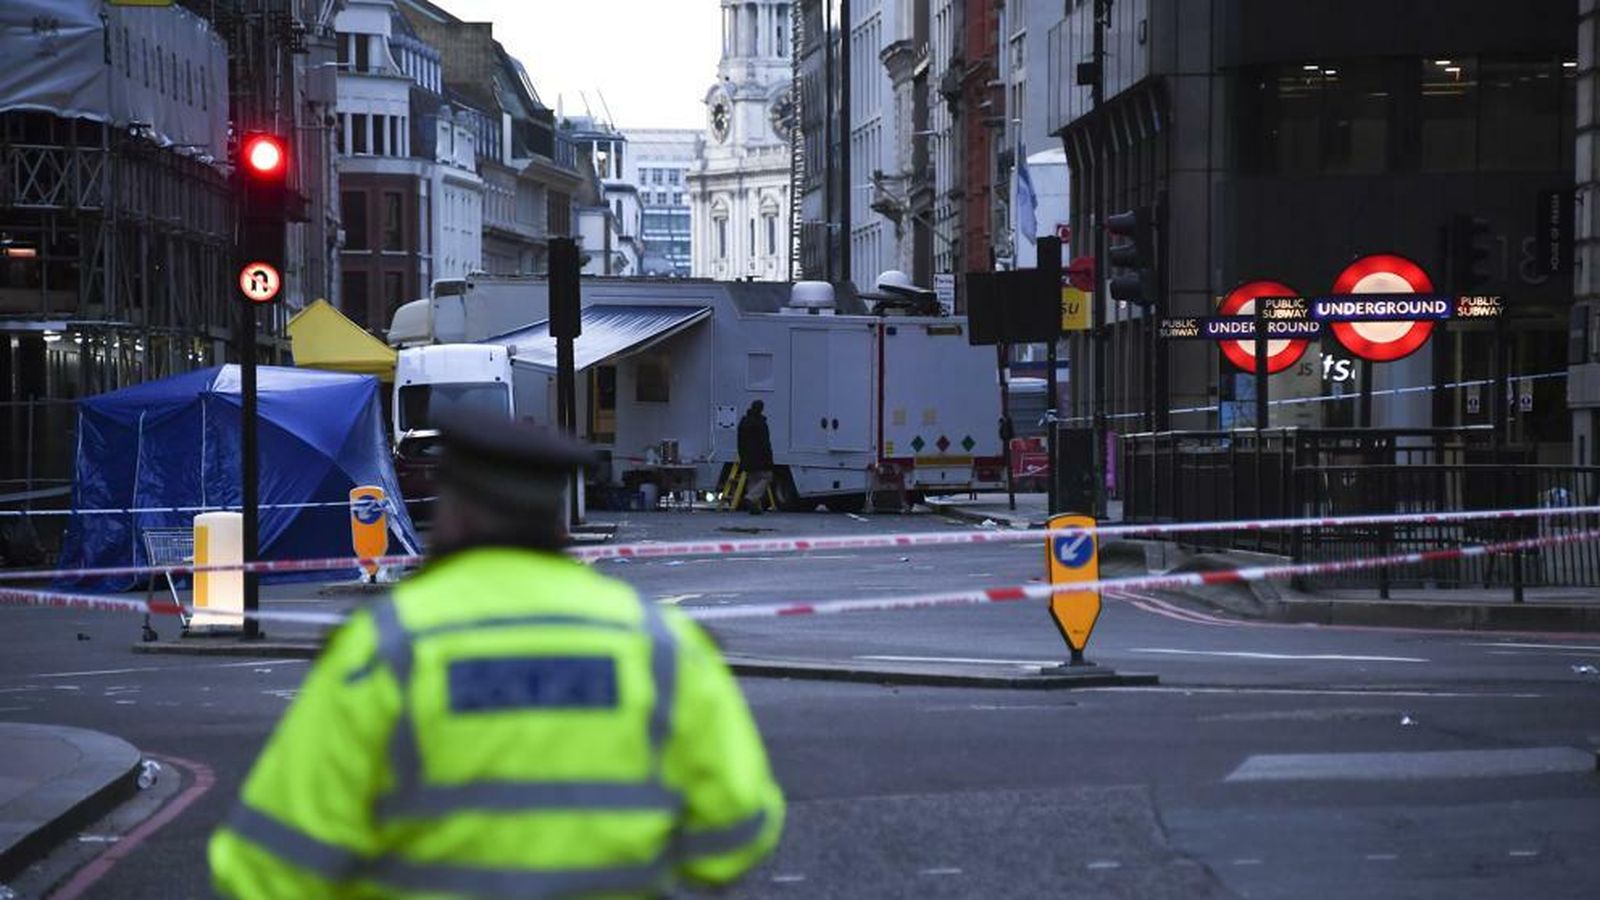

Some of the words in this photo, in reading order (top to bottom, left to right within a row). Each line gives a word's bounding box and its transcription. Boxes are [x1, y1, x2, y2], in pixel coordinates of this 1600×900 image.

[1265, 298, 1305, 308] PUBLIC
[1460, 296, 1501, 306] PUBLIC
[1318, 300, 1447, 316] UNDERGROUND
[1457, 306, 1504, 317] SUBWAY
[1262, 308, 1308, 319] SUBWAY
[1162, 318, 1197, 328] PUBLIC
[1208, 321, 1320, 334] UNDERROUND
[1159, 328, 1200, 337] SUBWAY
